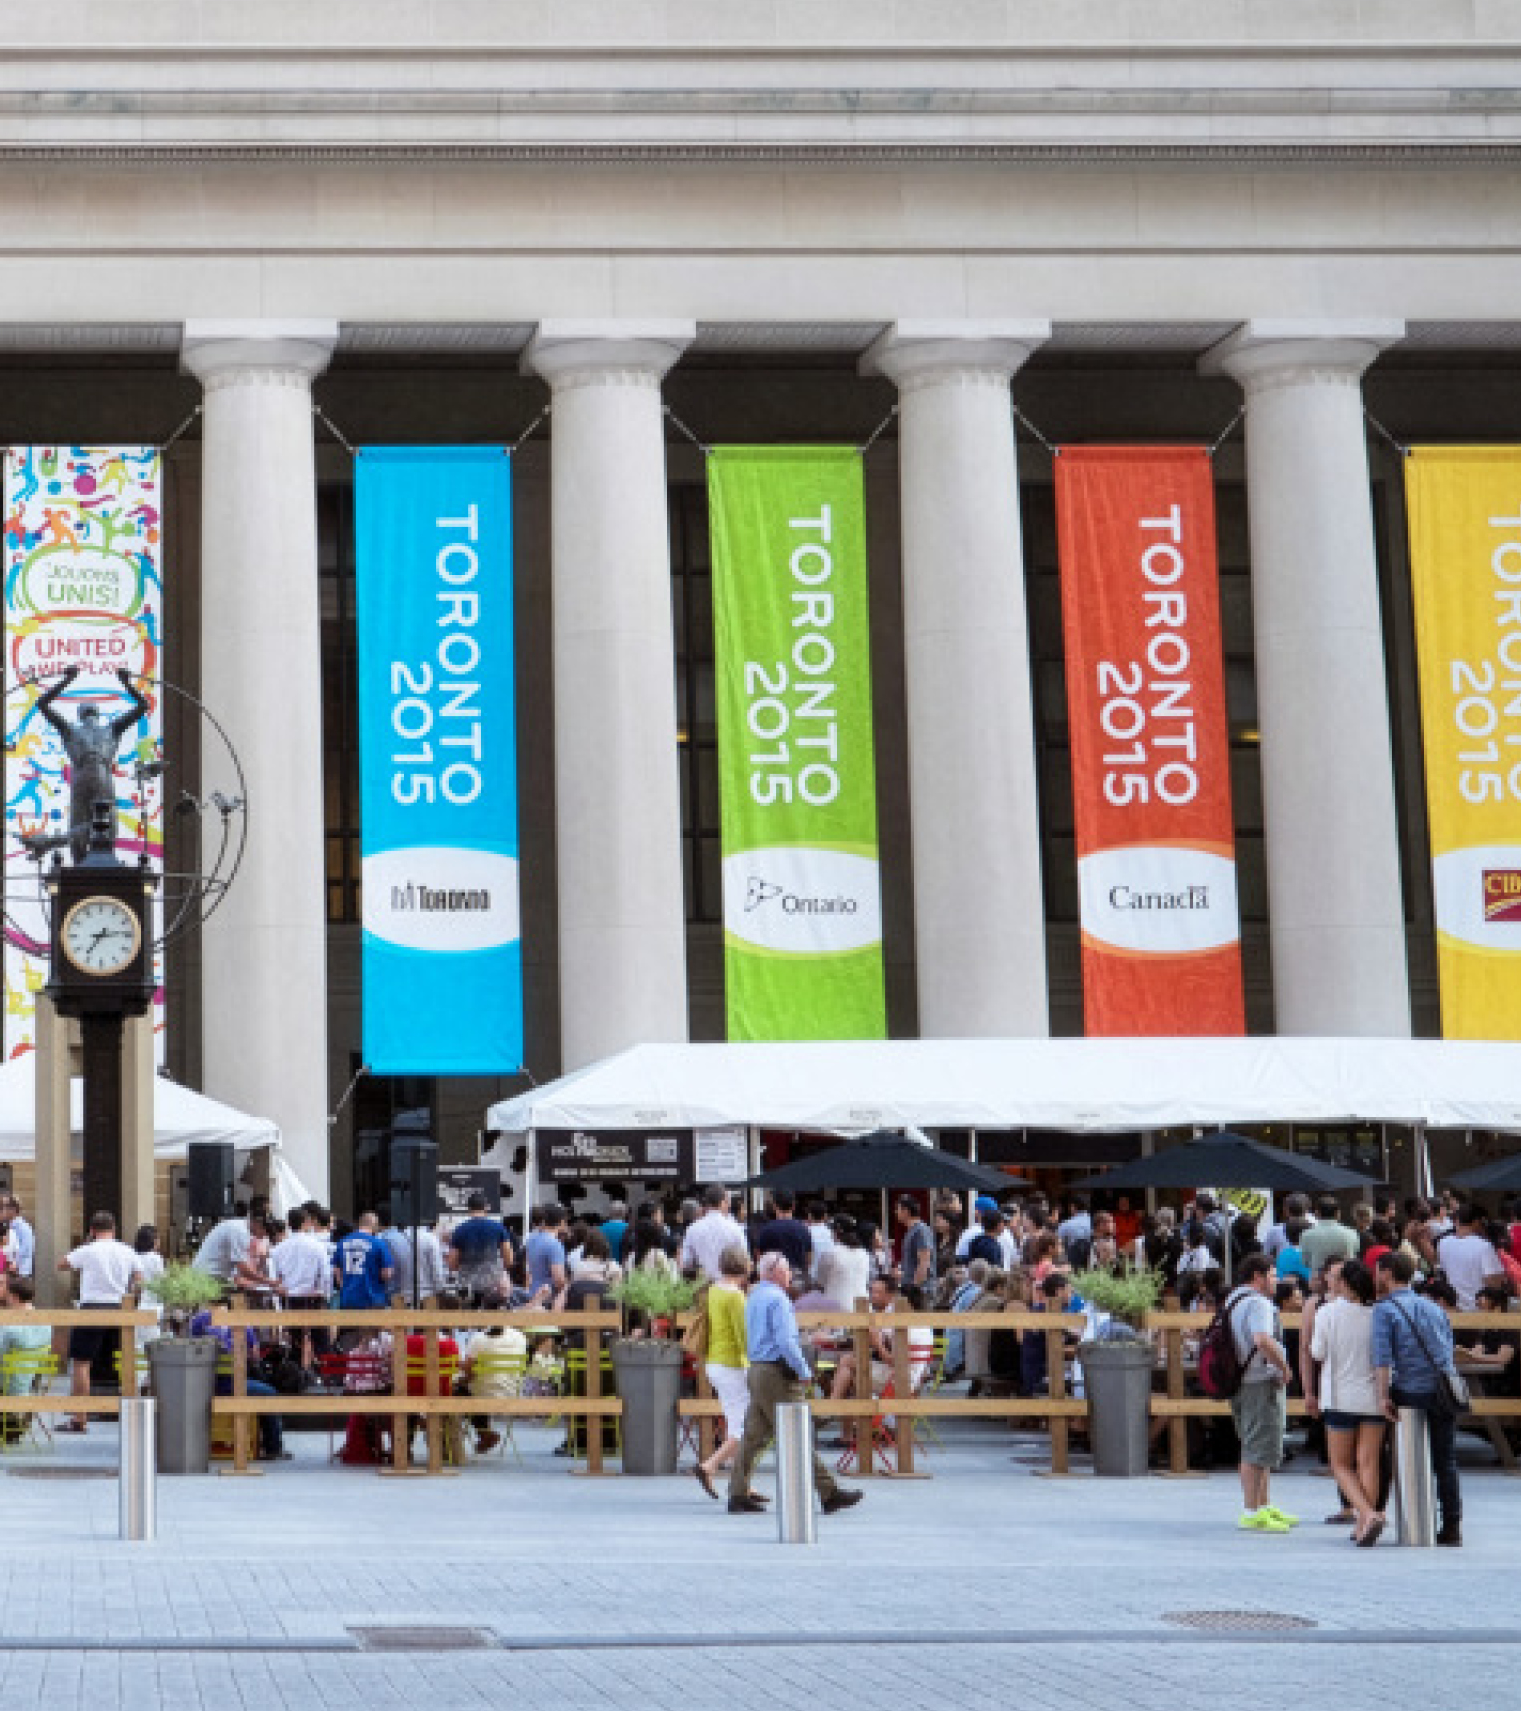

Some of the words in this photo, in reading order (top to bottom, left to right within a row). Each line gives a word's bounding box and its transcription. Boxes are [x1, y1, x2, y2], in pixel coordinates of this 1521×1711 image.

[34, 637, 127, 660] UNITED
[46, 584, 120, 606] UNIS!
[438, 504, 482, 805] TORONTO
[788, 504, 841, 807] TORONTO
[1140, 504, 1198, 805] TORONTO
[391, 661, 434, 805] 2015
[743, 661, 790, 807] 2015
[1096, 661, 1149, 807] 2015
[1451, 660, 1506, 805] 2015
[780, 894, 858, 915] Ontario
[1108, 885, 1210, 911] Canada
[344, 1250, 367, 1275] 12
